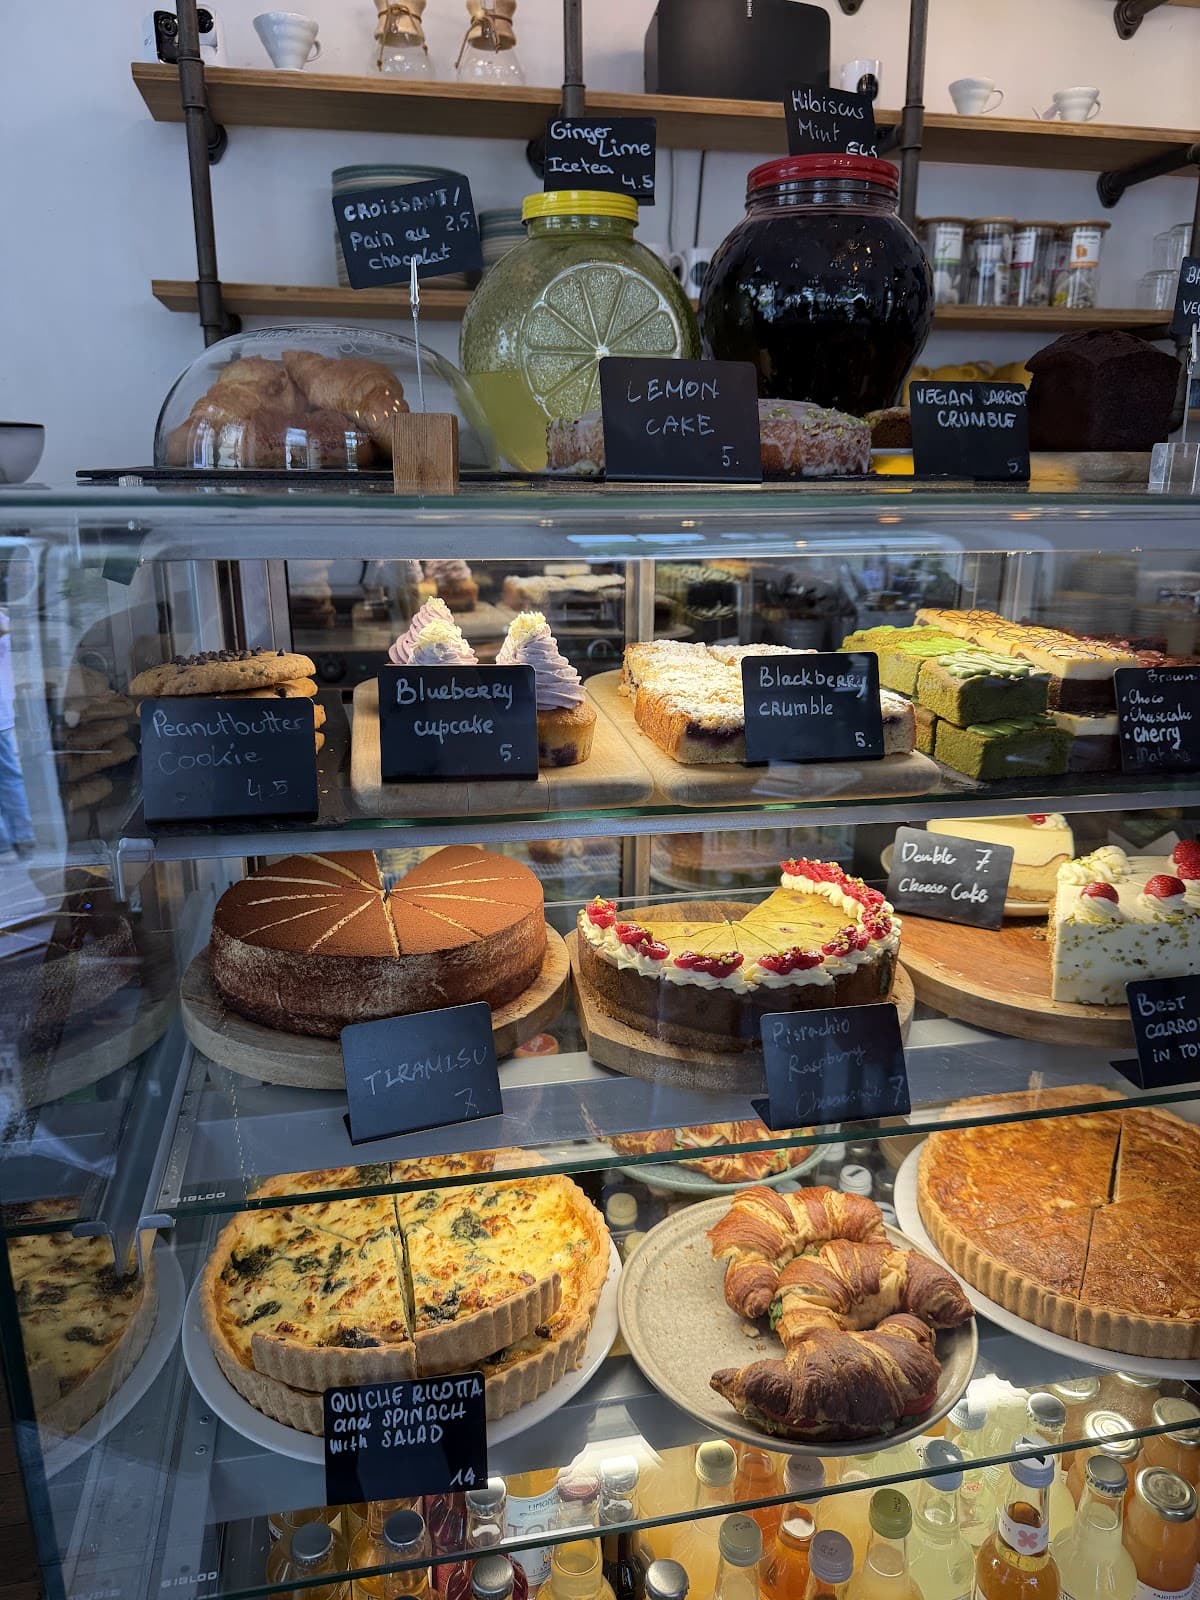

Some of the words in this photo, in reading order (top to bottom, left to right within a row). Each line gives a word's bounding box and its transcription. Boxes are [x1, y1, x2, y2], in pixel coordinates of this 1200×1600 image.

[792, 88, 864, 119] Hibiscus
[550, 120, 612, 145] Ginger
[798, 117, 840, 142] Mint
[599, 138, 651, 157] Lime
[548, 157, 614, 174] Icetea
[622, 174, 654, 189] 4.5
[350, 231, 394, 252] Pain
[405, 226, 430, 241] au
[369, 242, 451, 270] chocolat
[627, 377, 720, 403] LEMON
[916, 387, 973, 406] VEGAN
[646, 413, 715, 436] CAKE
[721, 445, 740, 468] 5.
[396, 676, 513, 710] Blueberry
[759, 665, 867, 698] Blackberry
[1129, 688, 1164, 704] Choco
[152, 709, 305, 738] Peanutbutter
[413, 714, 494, 745] cupcake
[854, 731, 872, 748] 5.
[1133, 726, 1182, 750] Cherry
[158, 743, 263, 776] Cookie
[499, 743, 521, 762] 5.
[901, 842, 957, 865] Double
[950, 882, 991, 904] Cake
[772, 1016, 850, 1048] Pistachio
[363, 1045, 487, 1096] TIRAMISU
[182, 1192, 226, 1203] IGLOO
[412, 1378, 482, 1404] RICOTTA
[334, 1412, 371, 1433] and
[382, 1402, 466, 1428] SPINACH
[382, 1424, 443, 1448] SALAD
